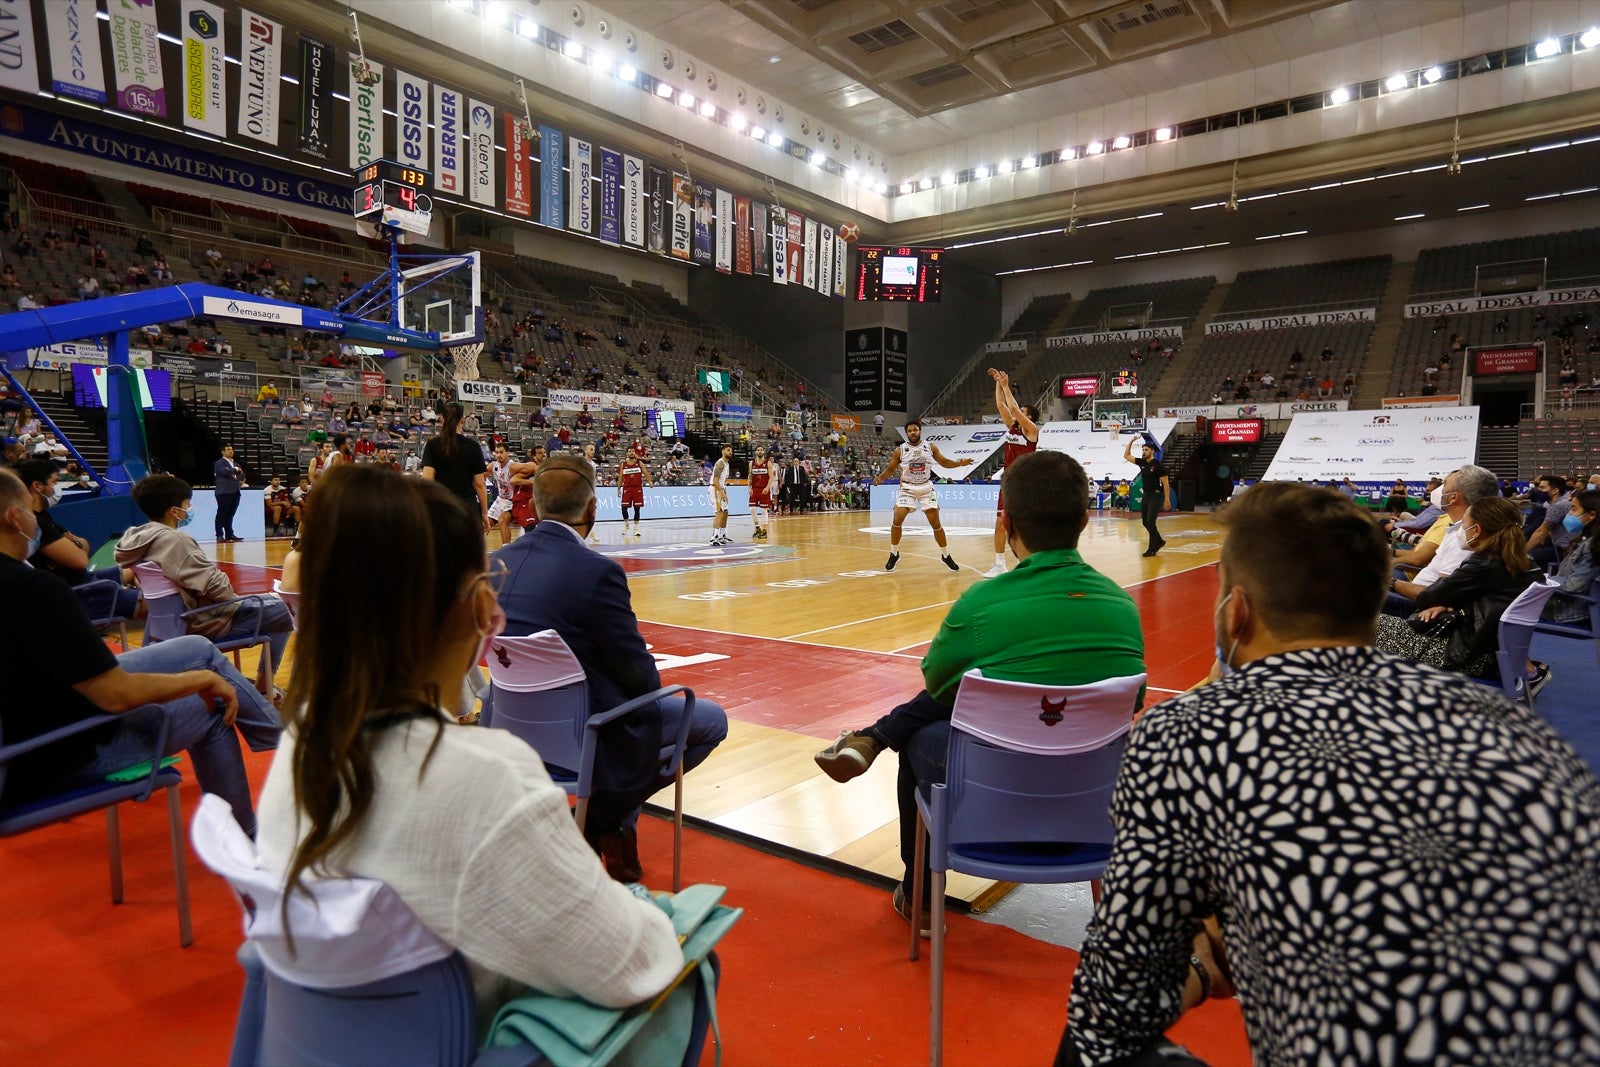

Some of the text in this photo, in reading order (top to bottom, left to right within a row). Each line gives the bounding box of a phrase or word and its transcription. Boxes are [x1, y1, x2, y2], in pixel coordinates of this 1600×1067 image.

[0, 0, 23, 70] AND
[112, 14, 130, 74] Deportes
[129, 19, 149, 83] Palacio de
[188, 39, 203, 120] ASCENSORES
[211, 46, 222, 110] cidesur
[247, 41, 266, 135] NEPTUNO
[130, 91, 156, 109] 16h
[310, 47, 321, 139] HOTEL LUNA
[403, 82, 422, 162] asisa
[441, 91, 457, 170] BERNER
[48, 119, 354, 212] AYUNTAMIENTO DE GRAN
[365, 165, 378, 180] 133
[478, 133, 492, 187] Cuerva
[402, 170, 424, 186] 133
[514, 163, 523, 200] LUNA
[401, 187, 414, 210] 4
[581, 162, 590, 230] ESCOLANO
[552, 205, 560, 226] JAVI
[630, 179, 638, 242] emasagra
[674, 213, 690, 250] enPie
[775, 223, 784, 264] sisa
[867, 251, 878, 259] 22
[898, 248, 911, 256] 133
[240, 308, 280, 320] emasagra
[1410, 288, 1600, 316] IDEAL IDEAL IDEA
[319, 320, 343, 329] MONDO
[1209, 310, 1369, 334] IDEAL IDEAL IDEAL
[387, 335, 408, 343] MONDO
[1050, 328, 1180, 348] IDEAL IDEAL IDEAL
[1480, 351, 1533, 360] AYUNTAMIENTO
[463, 382, 501, 397] asisa
[1290, 402, 1337, 411] CENTER
[1423, 415, 1473, 423] JURAND
[969, 491, 999, 500] CLUB
